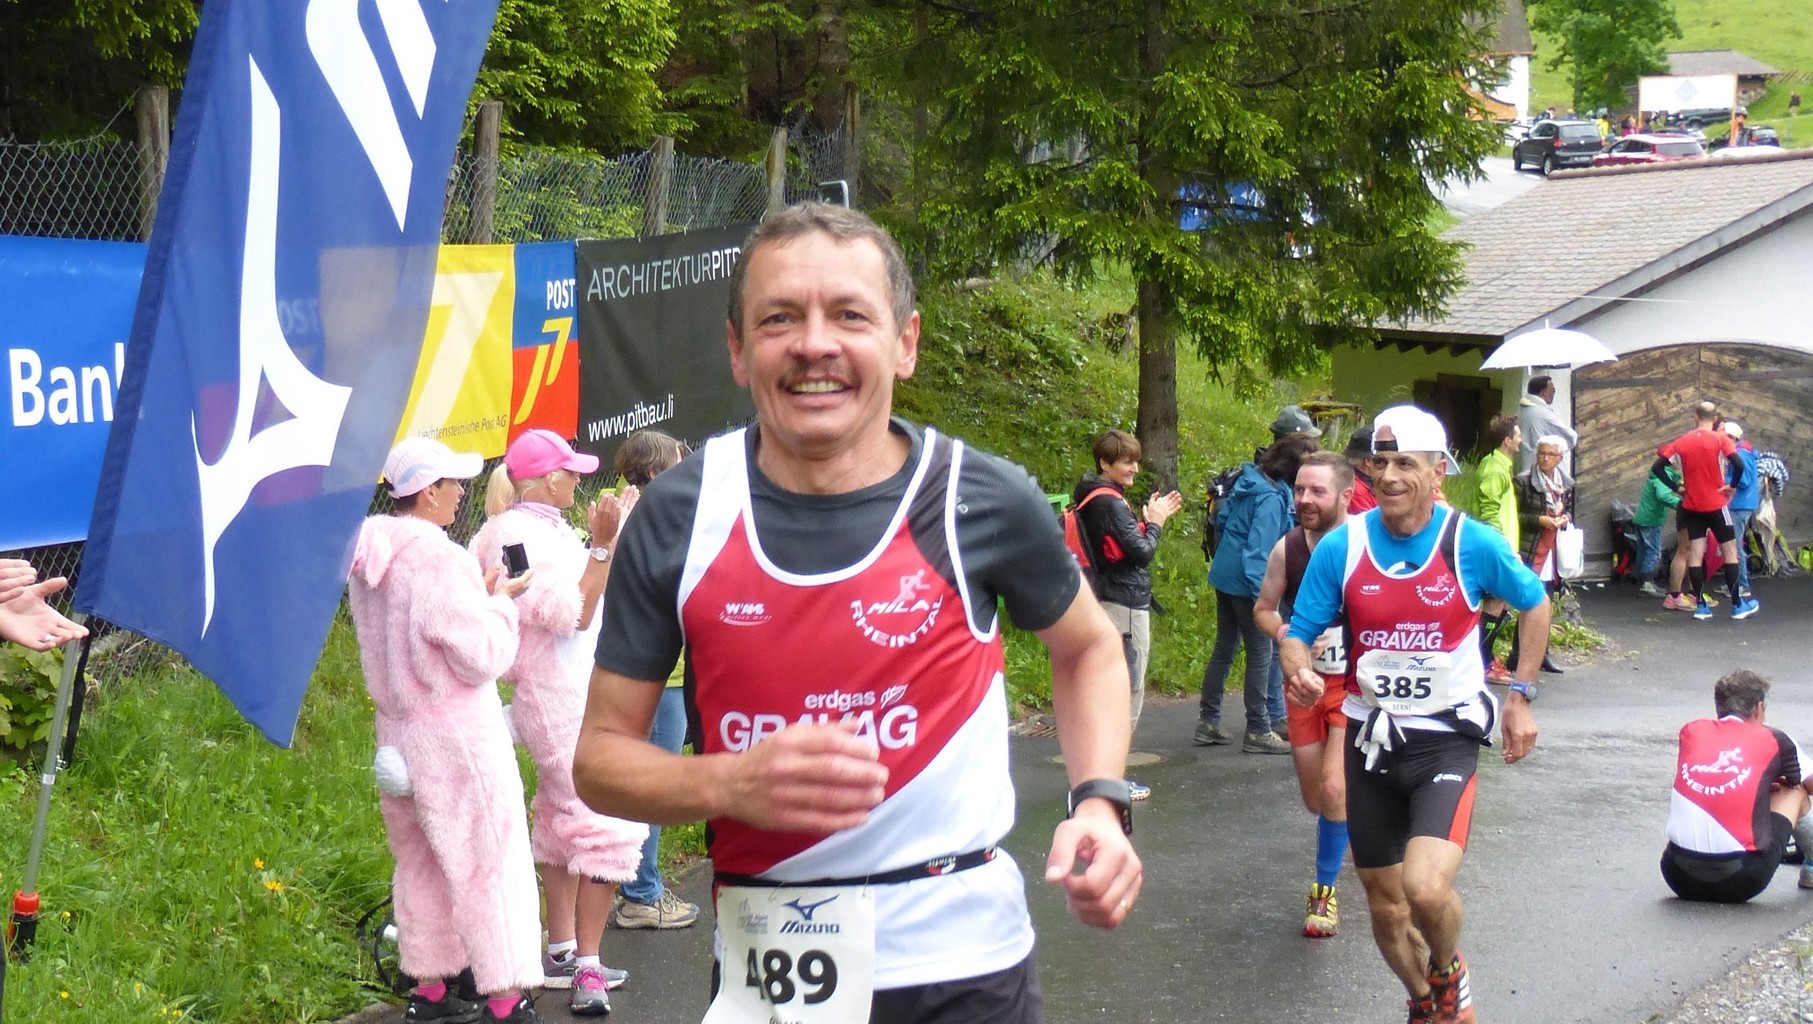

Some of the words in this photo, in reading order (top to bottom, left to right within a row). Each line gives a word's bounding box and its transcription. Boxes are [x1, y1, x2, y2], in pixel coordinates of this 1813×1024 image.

[546, 278, 576, 311] POST
[278, 298, 320, 335] OST
[495, 414, 507, 428] AG
[588, 393, 674, 442] www.pitbau.li
[866, 599, 930, 615] MILA
[850, 594, 944, 648] RHEINTAL
[1395, 622, 1426, 632] erdgas
[1358, 630, 1444, 650] GRAVAG
[1374, 674, 1432, 699] 385
[804, 688, 876, 713] erdgas
[746, 946, 838, 1005] 489
